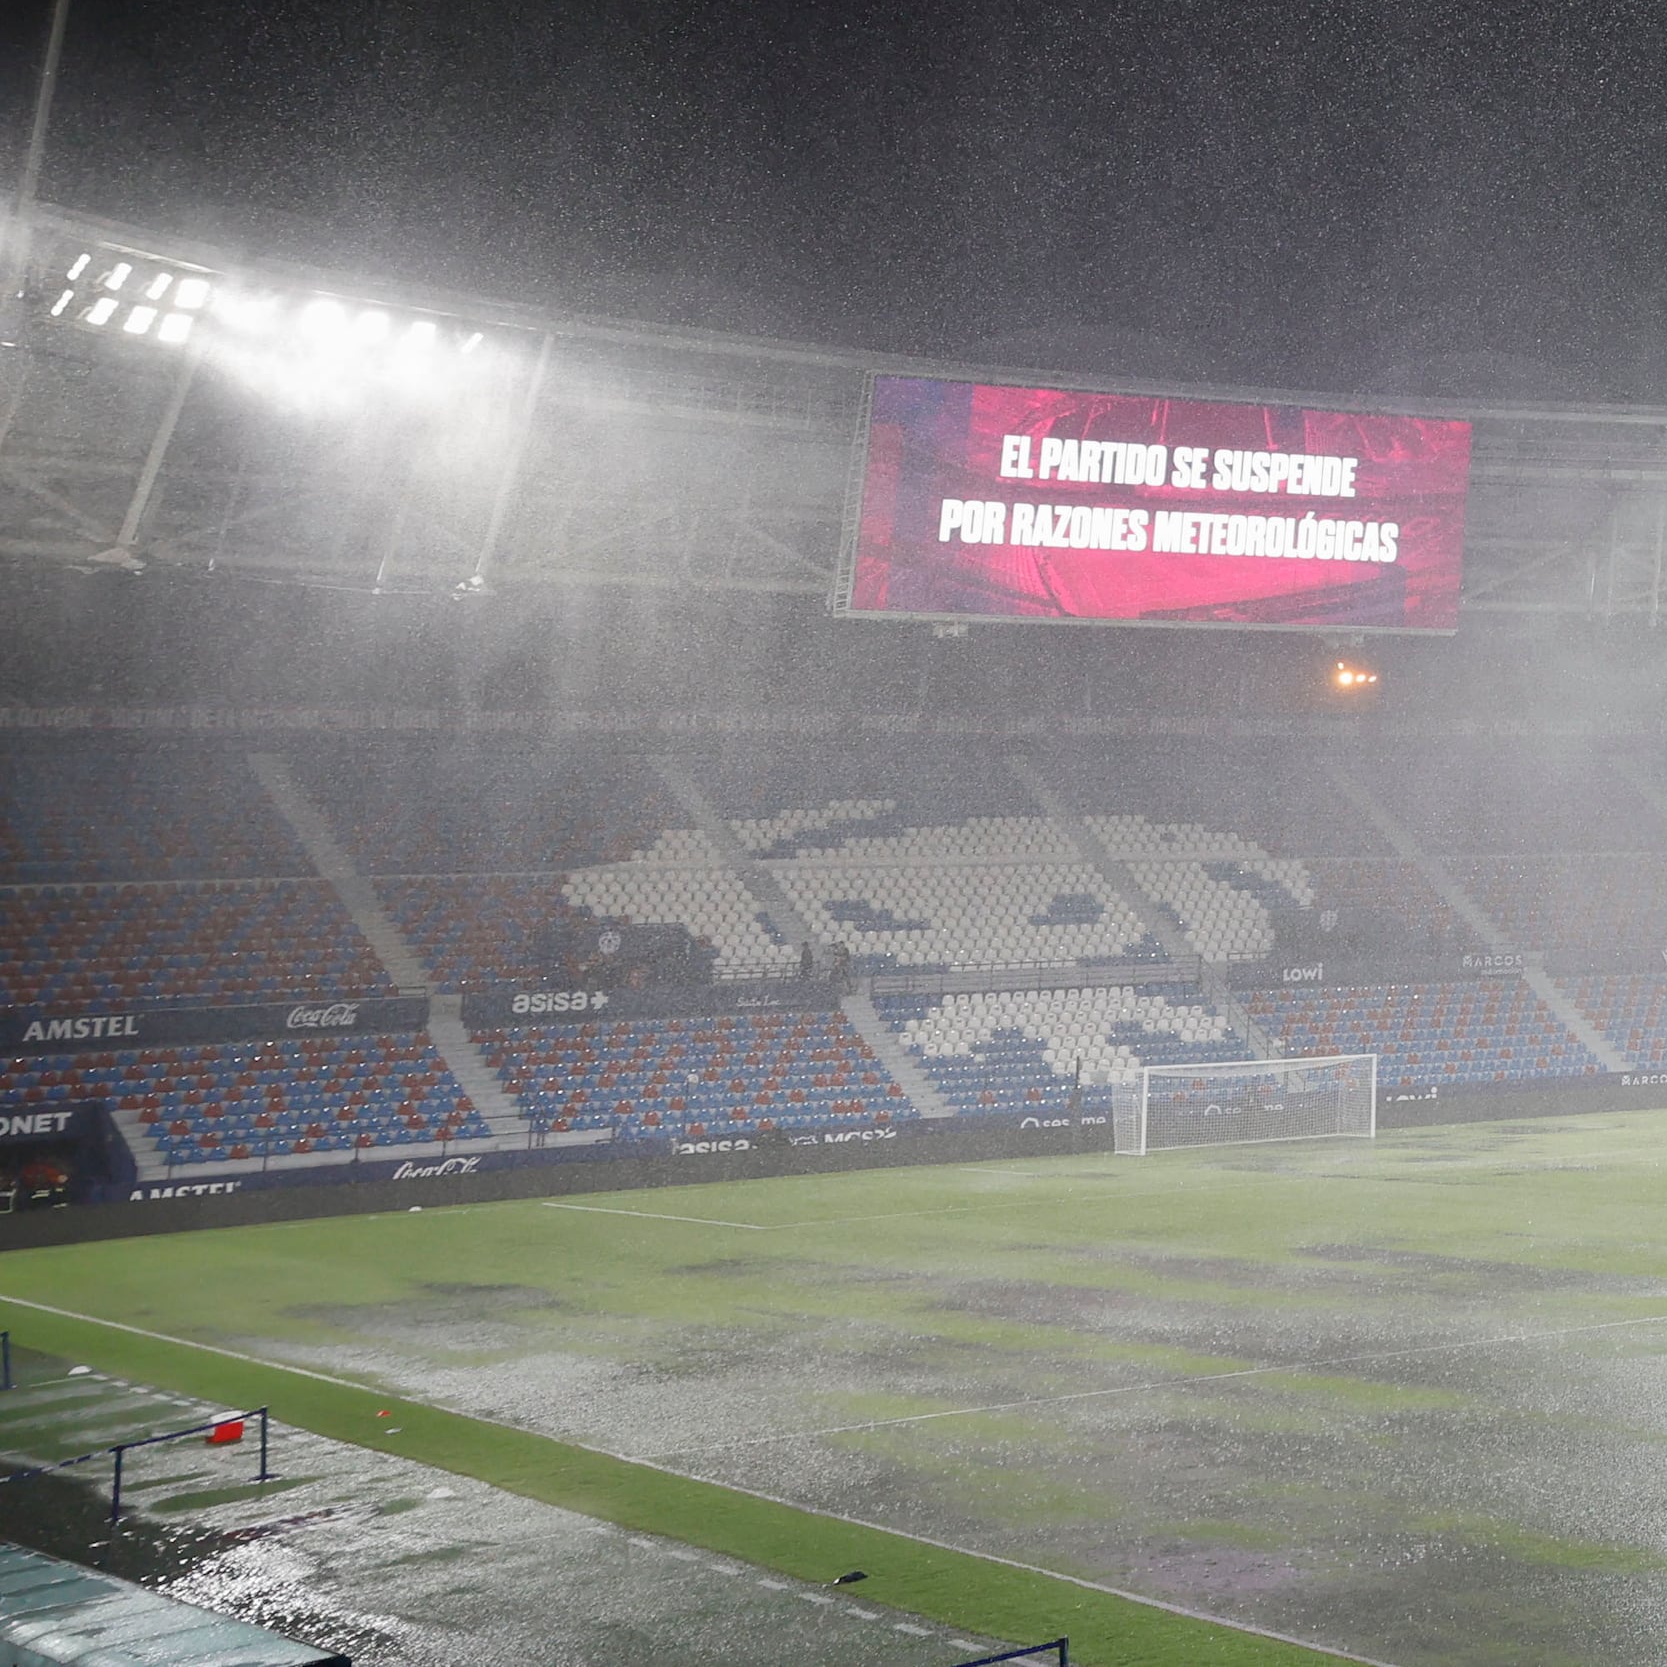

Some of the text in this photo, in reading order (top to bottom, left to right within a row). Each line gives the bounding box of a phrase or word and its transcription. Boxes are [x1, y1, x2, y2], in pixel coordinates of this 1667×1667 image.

[999, 434, 1358, 498] EL PARTIDO SE SUSPENDE
[938, 499, 1400, 563] POR RAZONES METEOROLÓGICAS
[1462, 955, 1522, 968] MARCOS
[512, 992, 588, 1014] asisa
[22, 1015, 140, 1042] AMSTEL
